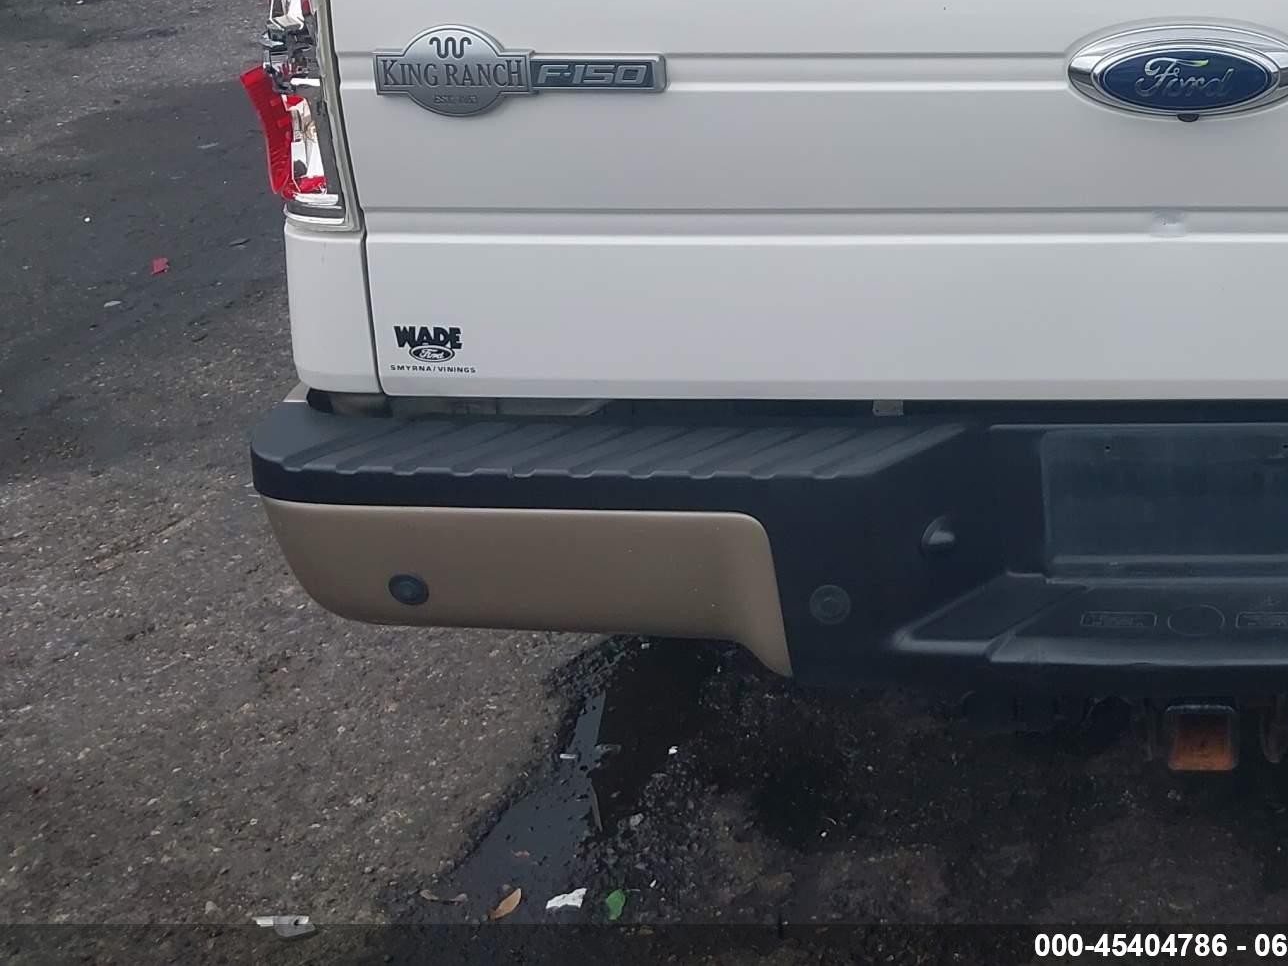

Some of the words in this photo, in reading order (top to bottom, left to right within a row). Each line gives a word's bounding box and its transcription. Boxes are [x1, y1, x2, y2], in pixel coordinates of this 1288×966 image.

[380, 58, 438, 87] KING
[441, 58, 523, 87] RANCH
[1135, 57, 1234, 98] Ford
[393, 325, 463, 349] WADE
